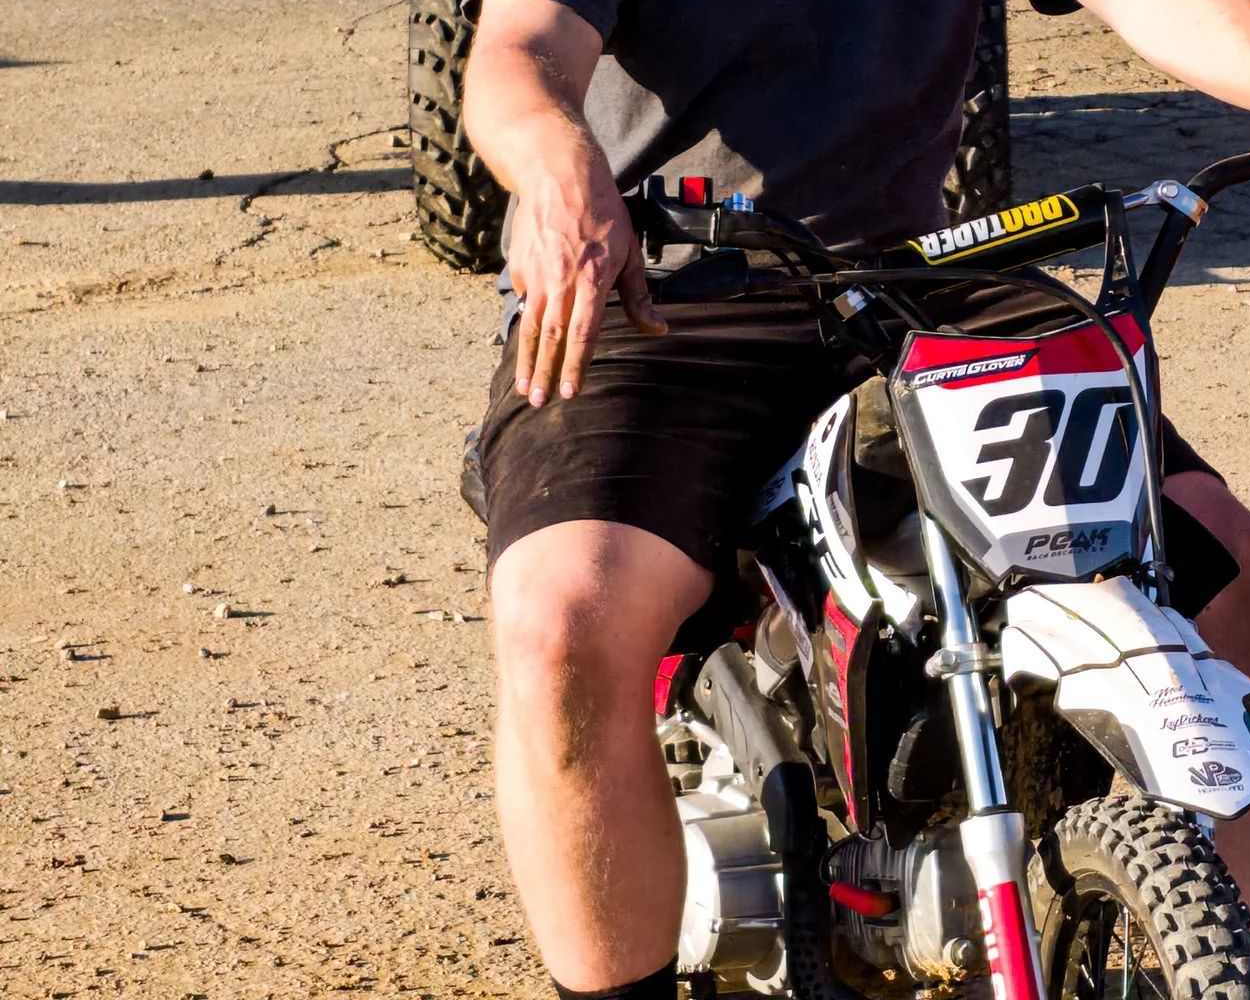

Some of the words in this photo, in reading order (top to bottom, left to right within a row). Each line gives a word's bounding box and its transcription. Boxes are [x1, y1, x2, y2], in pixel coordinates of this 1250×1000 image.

[913, 364, 968, 385] CURTIS
[966, 353, 1027, 375] GLOVER
[961, 386, 1140, 517] 30
[1024, 528, 1113, 556] PEAK
[1188, 761, 1225, 786] VP
